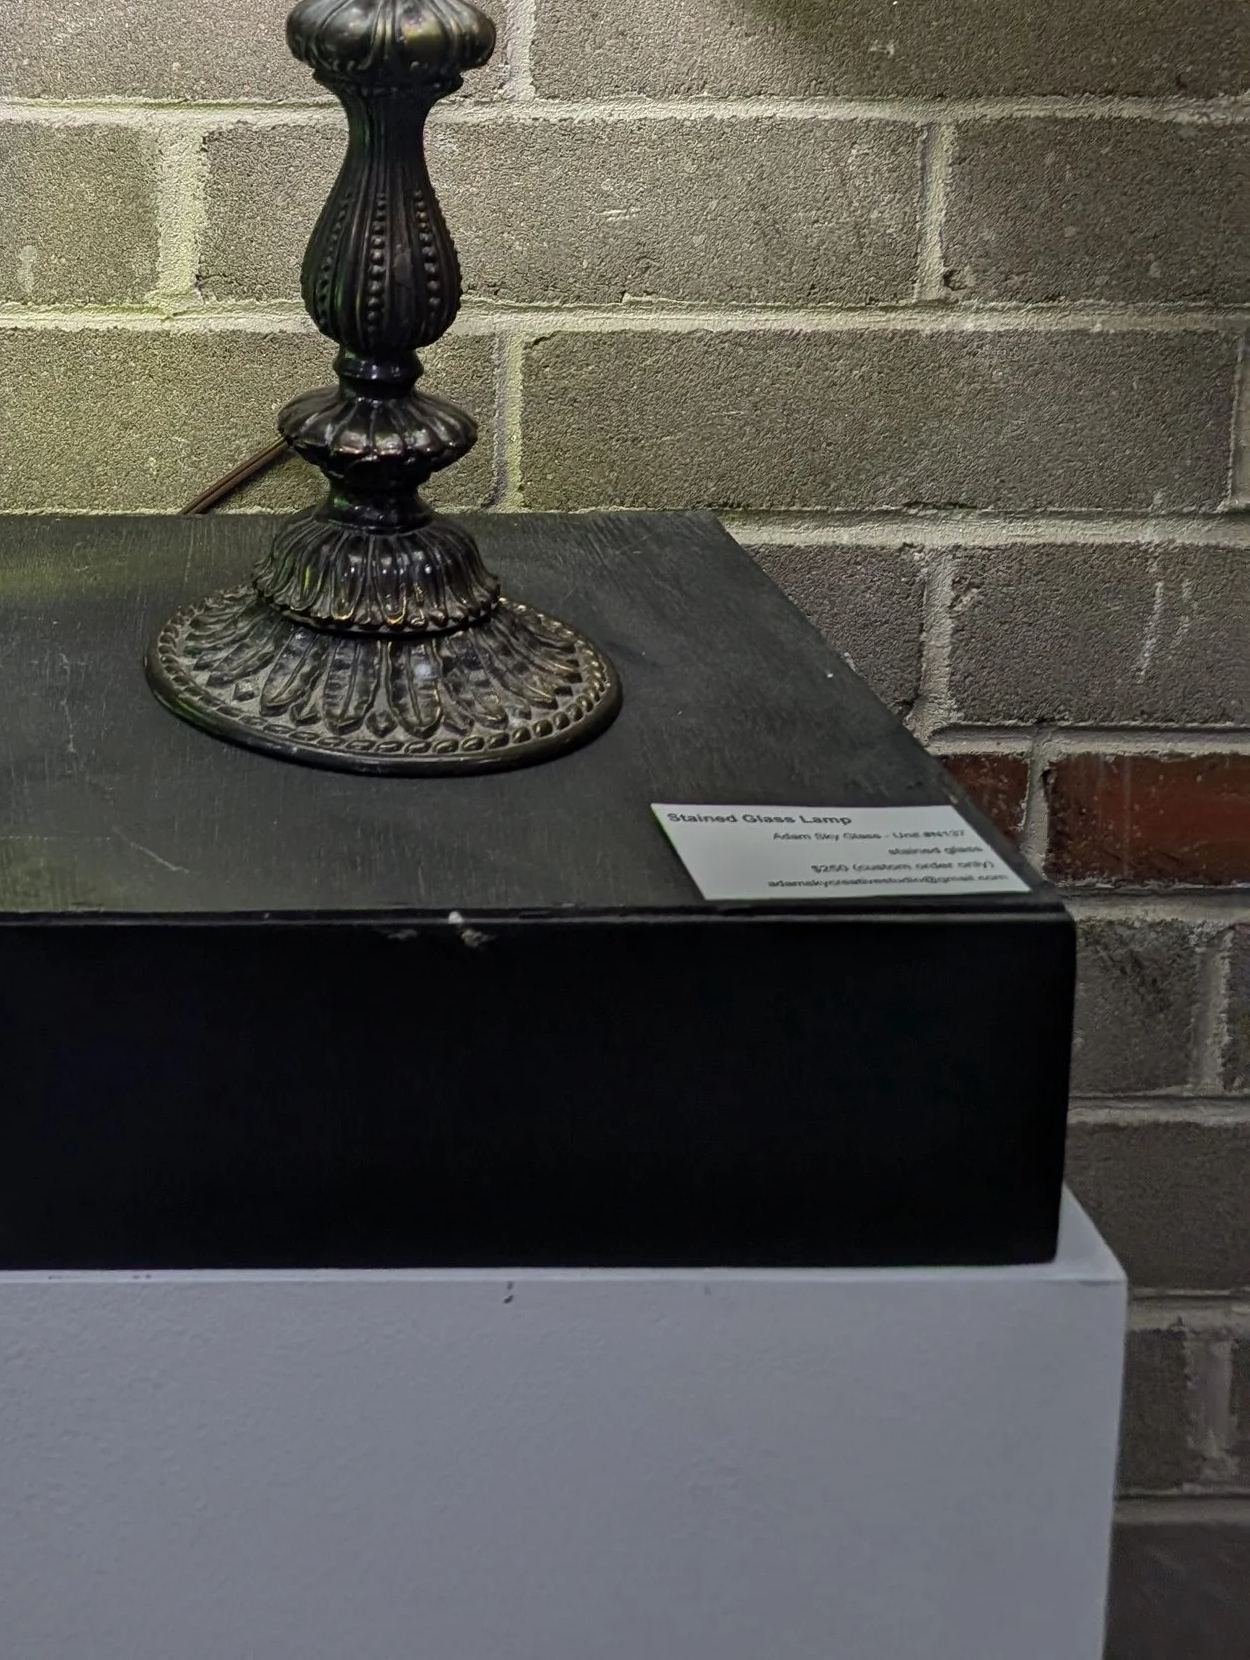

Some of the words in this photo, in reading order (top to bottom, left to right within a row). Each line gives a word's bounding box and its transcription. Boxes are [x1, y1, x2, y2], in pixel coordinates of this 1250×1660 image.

[667, 812, 738, 824] Stained
[742, 813, 796, 824] Glass
[798, 814, 852, 826] Lamp
[773, 831, 811, 840] Adam
[814, 832, 839, 842] Sky
[888, 846, 941, 855] stained
[944, 846, 983, 855] glass
